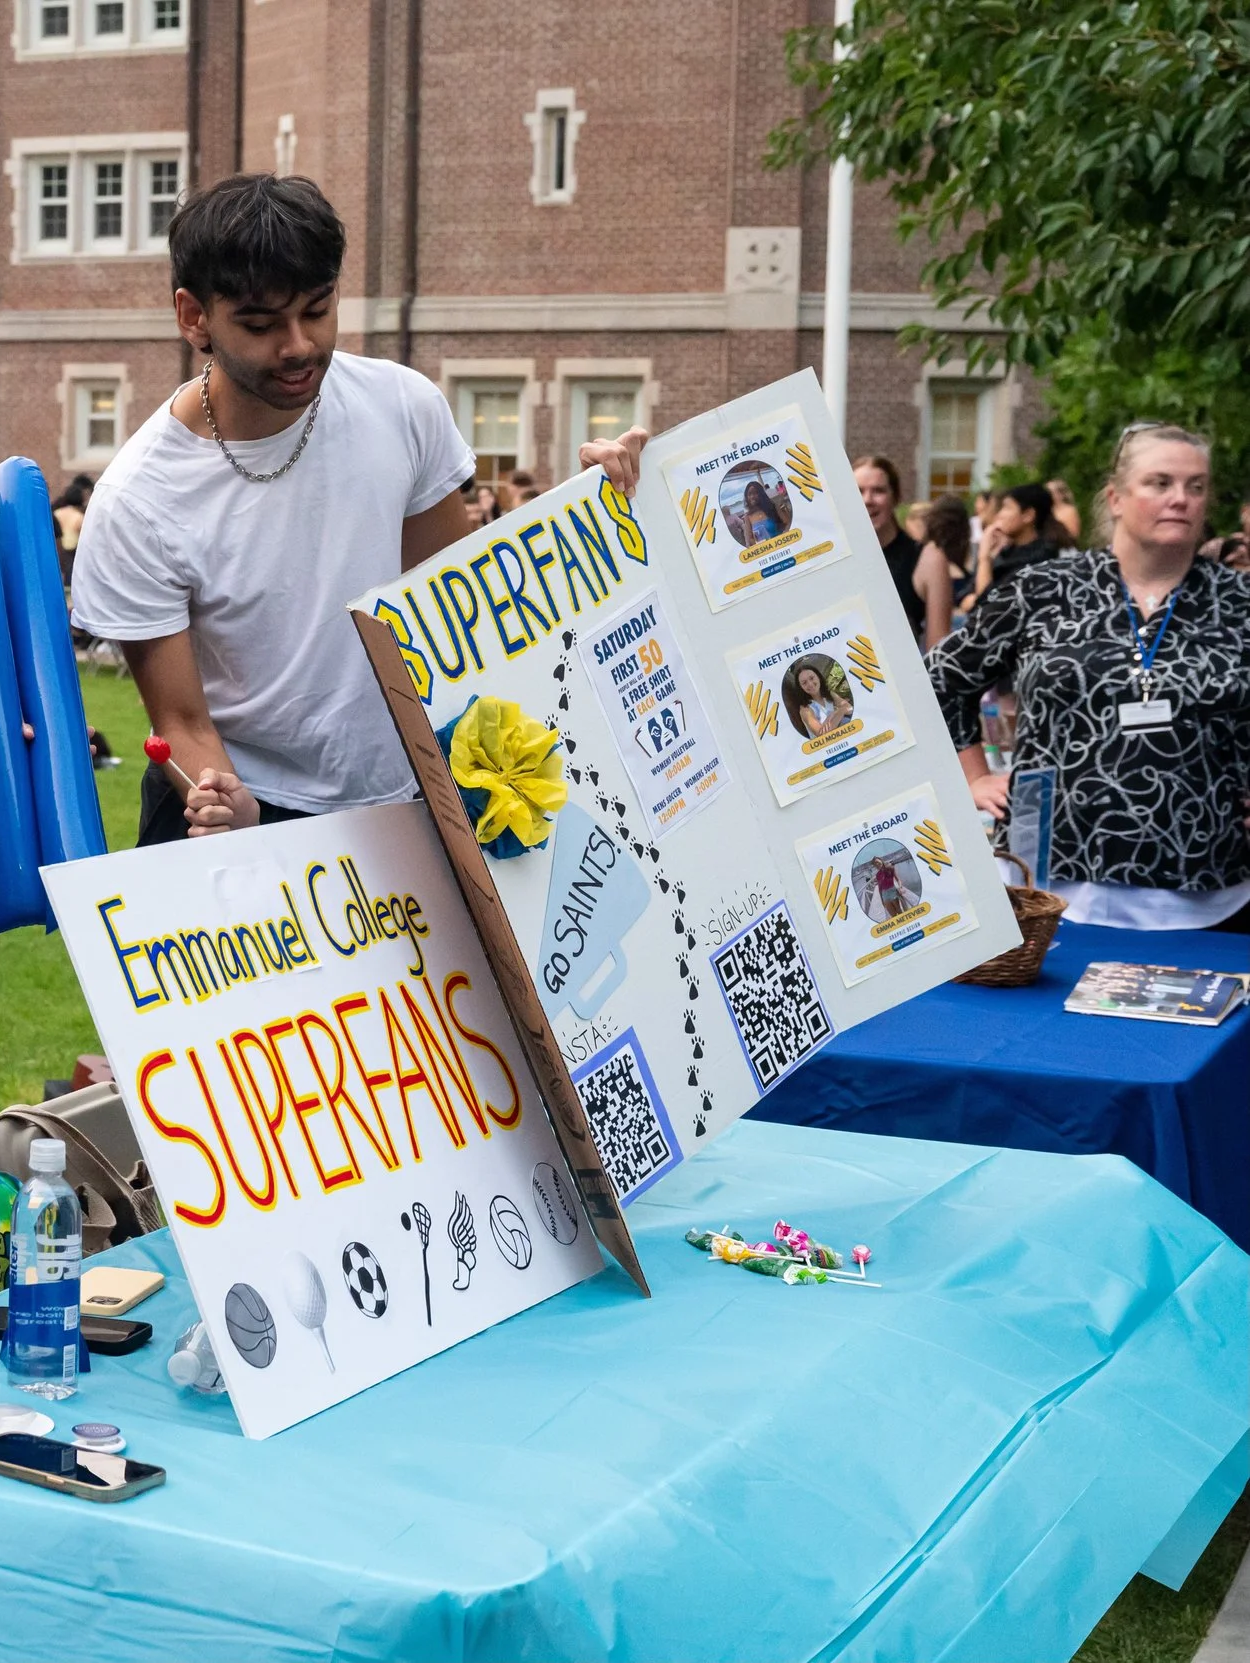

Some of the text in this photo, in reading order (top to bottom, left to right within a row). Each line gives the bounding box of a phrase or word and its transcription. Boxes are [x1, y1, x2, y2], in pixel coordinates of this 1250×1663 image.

[695, 434, 780, 476] MEET THE EBOARD
[743, 532, 800, 561] LANESHA JOSEPH
[373, 474, 649, 705] SUPERFANS
[593, 604, 657, 665] SATURDAY
[758, 627, 840, 670] MEET THE EBOARD
[610, 638, 663, 686] FIRST 50
[621, 664, 672, 710] A FREE SHIRT
[627, 680, 677, 723] AT EACH GAME
[650, 737, 696, 777] WOMENS VOLLEYBALL
[809, 738, 825, 750] LOLI
[825, 724, 856, 743] MORALES
[664, 754, 692, 782] 10:00AM
[683, 757, 720, 789] WOMENS SOCCER
[694, 772, 718, 796] 3:00PM
[652, 787, 683, 815] MENS SOCCER
[658, 798, 687, 825] 12:00PM
[828, 812, 908, 856] MEET THE EBOARD
[543, 824, 622, 995] GO SAINTS!
[876, 922, 895, 935] EMMA
[97, 855, 430, 1015] Emmanuel College
[561, 1025, 611, 1064] NSTA:
[136, 970, 523, 1228] SUPERFANS
